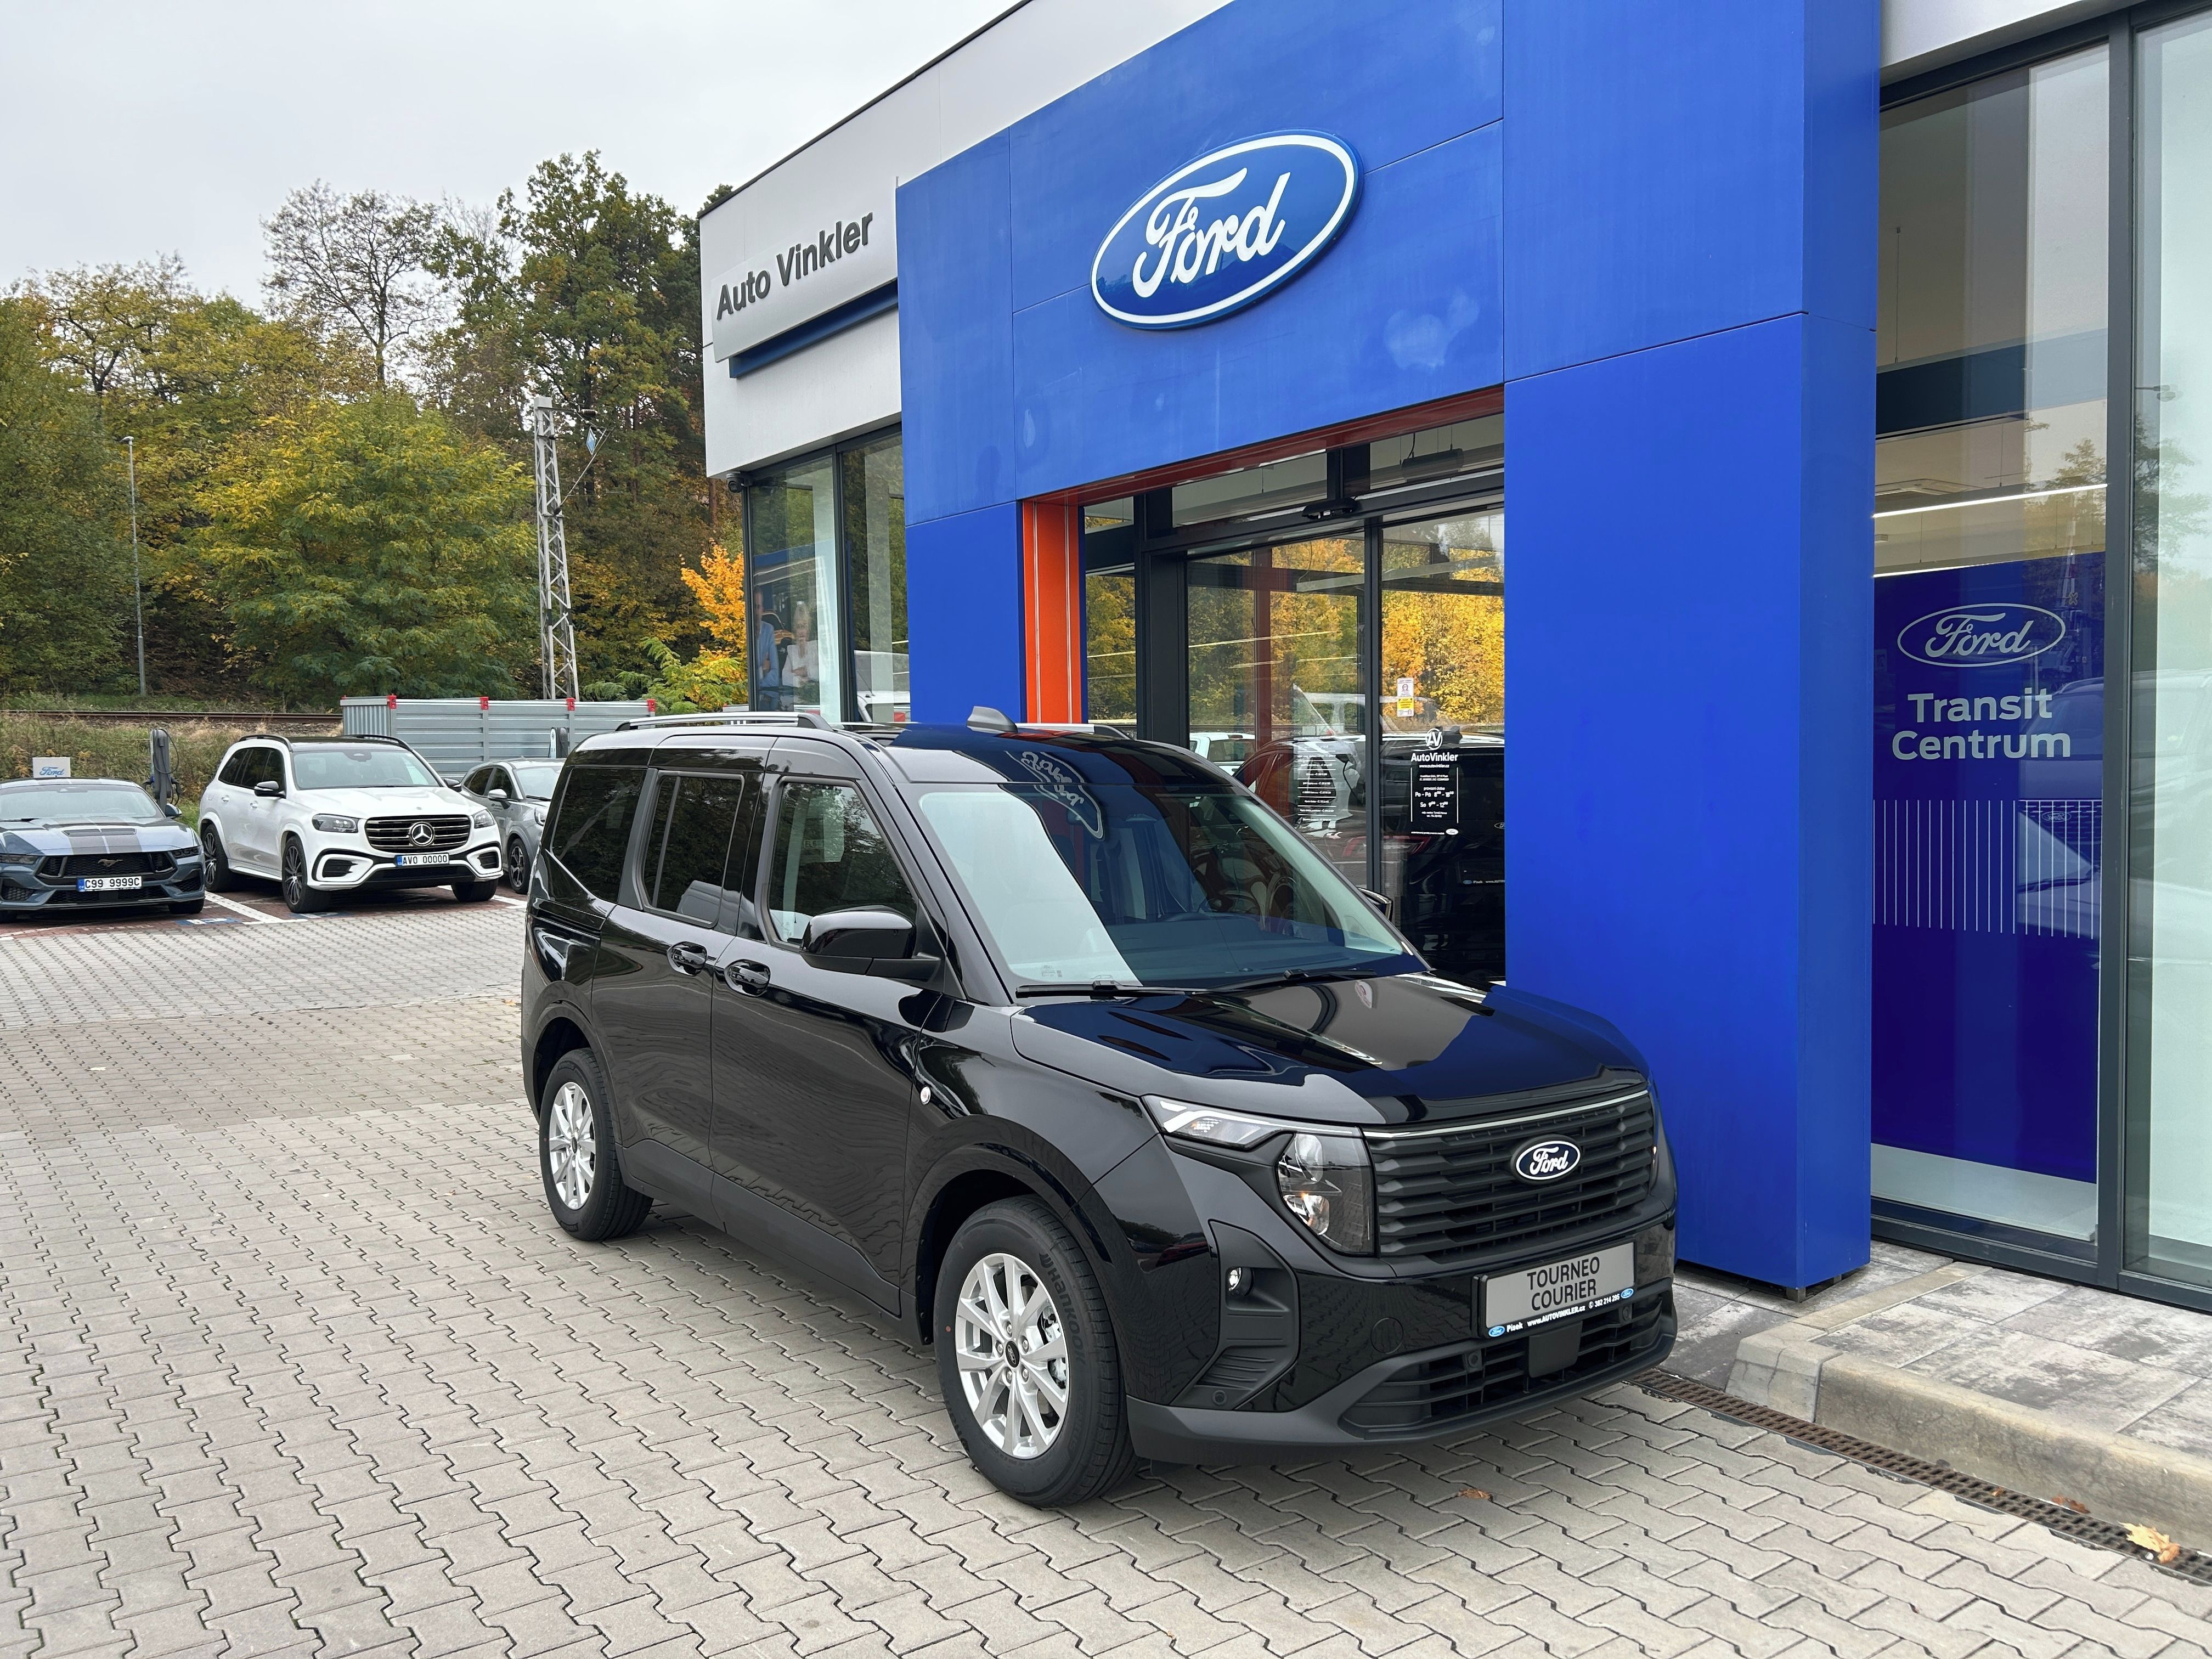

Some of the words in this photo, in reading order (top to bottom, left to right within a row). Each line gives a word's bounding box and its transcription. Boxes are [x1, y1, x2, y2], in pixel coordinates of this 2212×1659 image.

[1133, 167, 1291, 298] Ford
[716, 271, 771, 321] Auto
[776, 212, 873, 287] Vinkler
[1925, 612, 2034, 658] Ford
[1908, 687, 2052, 723] Transit
[1410, 752, 1459, 762] AutoVinkler
[1892, 730, 2071, 760] Centrum
[40, 766, 65, 775] Ford
[422, 855, 447, 864] 00000
[85, 879, 104, 889] C99
[109, 878, 140, 887] 9999C
[1530, 1147, 1568, 1175] Ford
[1527, 1256, 1600, 1290] TOURNEO
[1532, 1278, 1596, 1311] COURIER
[1527, 1305, 1586, 1327] www.AUTOVINKLER.cz
[1603, 1296, 1611, 1305] 214
